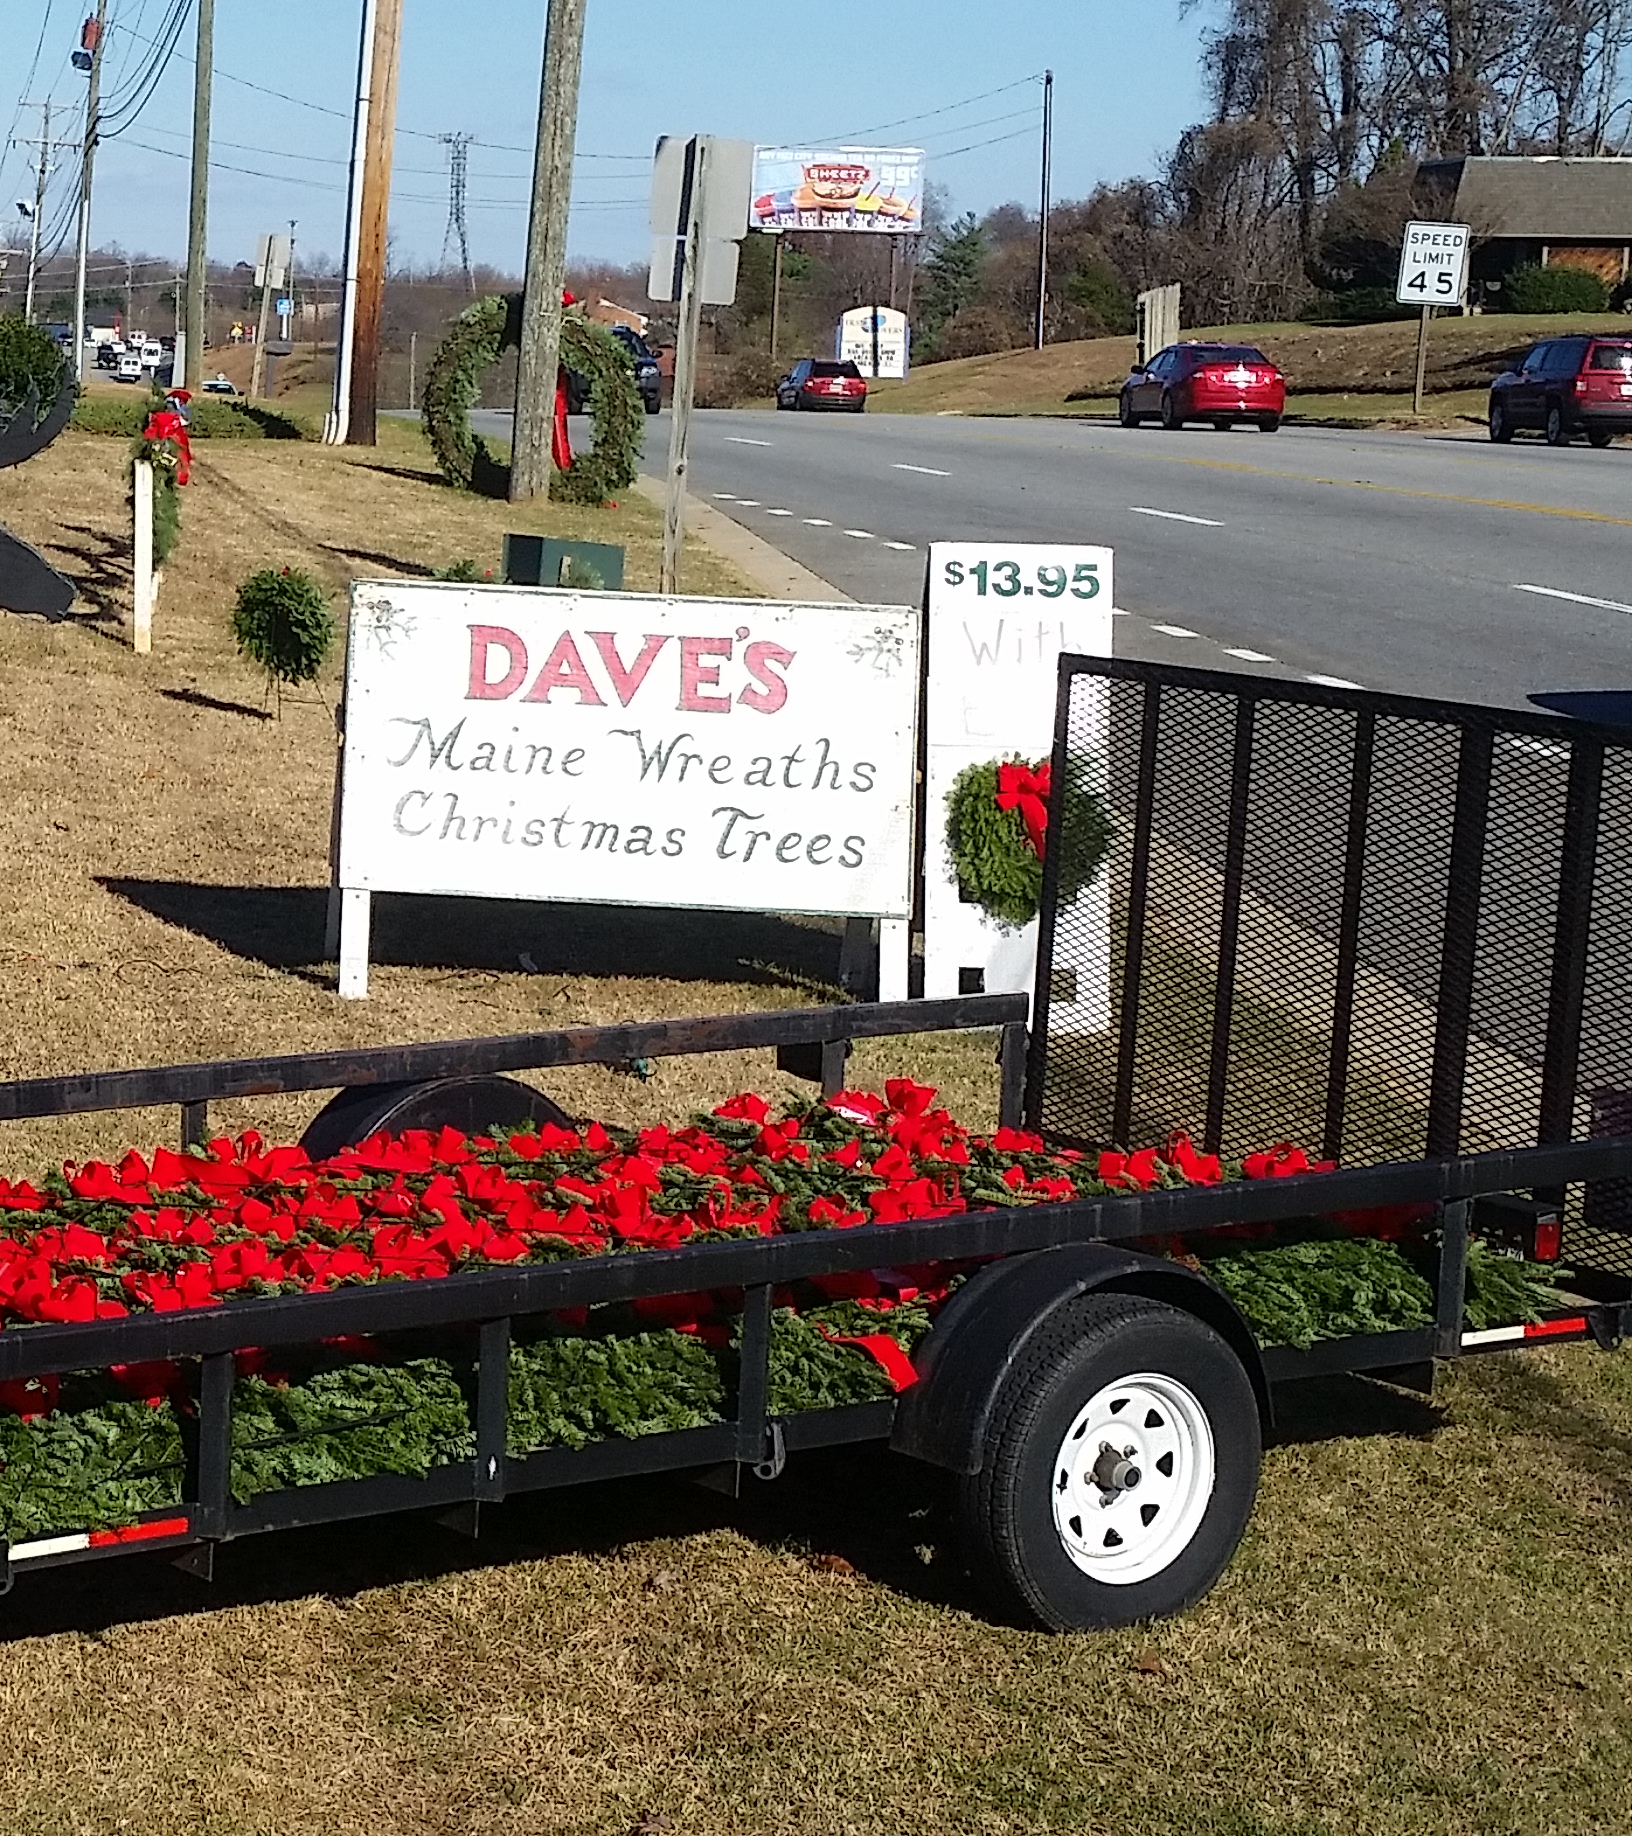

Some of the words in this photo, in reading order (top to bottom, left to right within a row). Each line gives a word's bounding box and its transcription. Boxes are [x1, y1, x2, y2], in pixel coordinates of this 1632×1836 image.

[809, 168, 866, 179] SHEETZ
[1410, 232, 1463, 247] SPEED
[1412, 251, 1454, 265] LIMIT
[1407, 270, 1453, 295] 45
[944, 560, 1100, 599] $13.95
[464, 624, 798, 714] DAVE'S
[386, 716, 586, 777] Maine
[607, 729, 878, 793] Wreaths
[393, 790, 687, 857] Christmas
[712, 806, 867, 869] Trees
